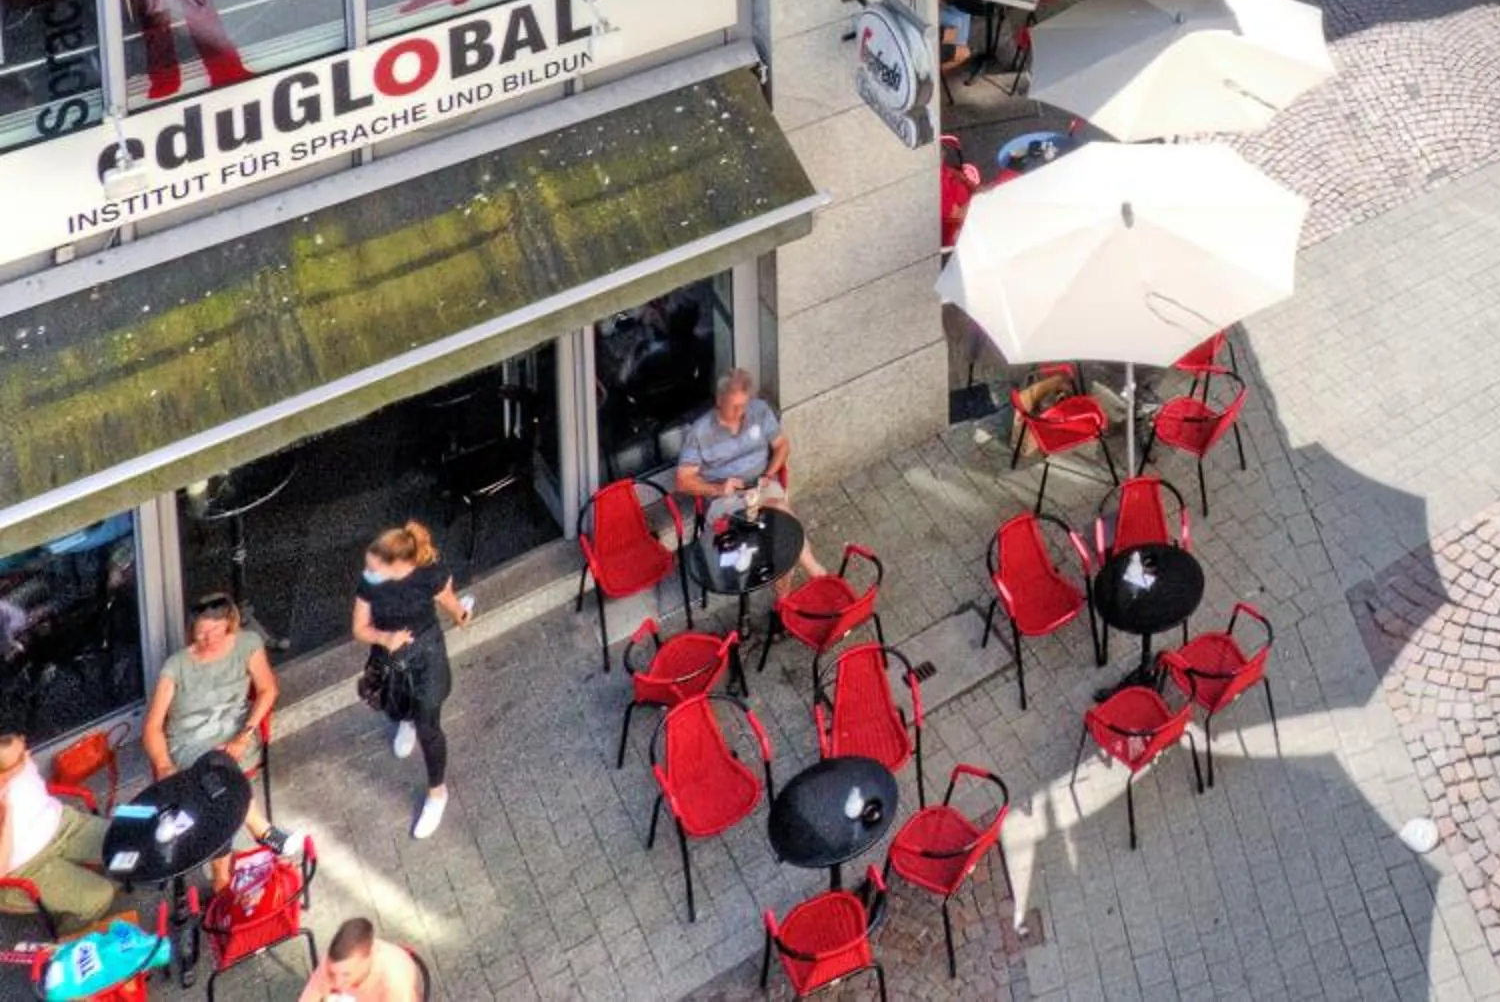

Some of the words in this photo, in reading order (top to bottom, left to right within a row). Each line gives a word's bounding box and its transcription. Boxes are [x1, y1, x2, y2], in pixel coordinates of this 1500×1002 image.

[68, 172, 211, 234] INSTITUT
[220, 151, 280, 185] FÜR
[290, 102, 427, 161] SPRACHE
[437, 81, 494, 115] UND
[502, 50, 593, 94] BILDUN
